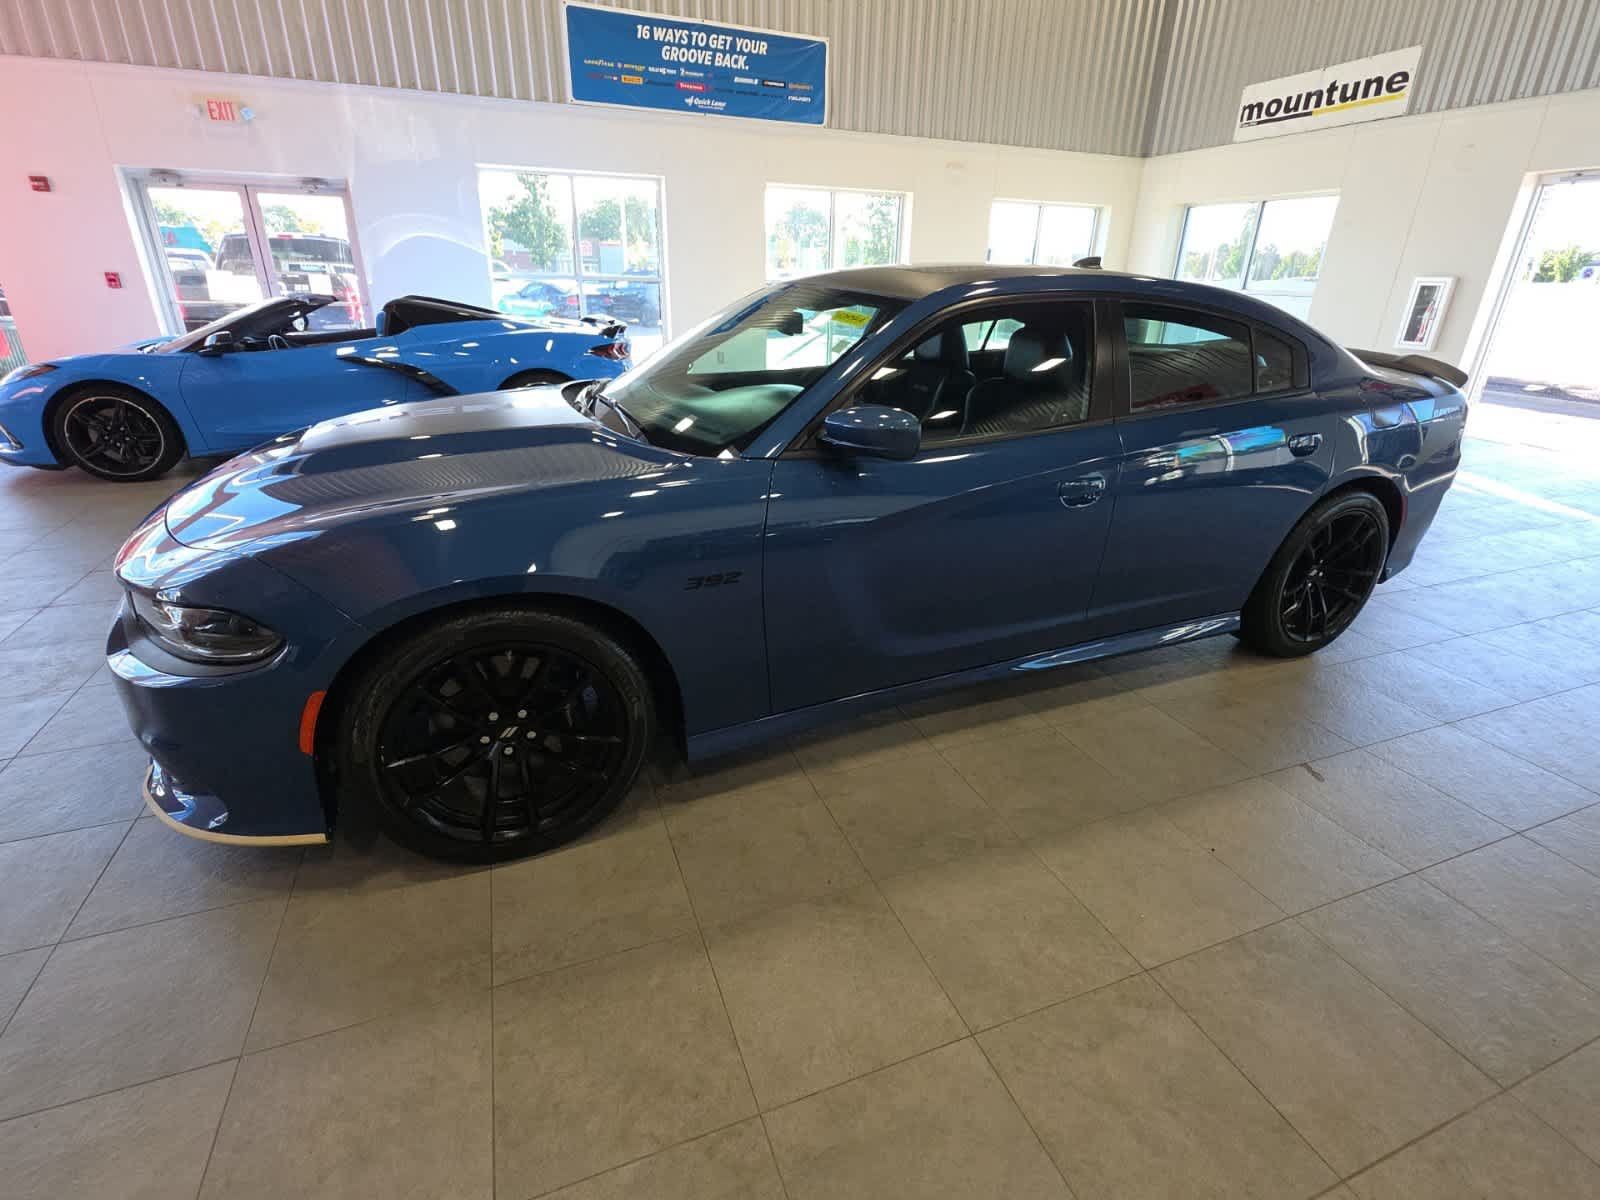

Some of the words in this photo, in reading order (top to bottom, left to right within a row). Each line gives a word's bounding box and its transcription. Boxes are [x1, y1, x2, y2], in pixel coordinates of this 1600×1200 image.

[636, 24, 650, 39] 16
[653, 26, 689, 45] WAYS
[691, 31, 707, 47] TO
[709, 33, 733, 50] GET
[735, 37, 768, 55] YOUR
[661, 45, 712, 65] GROOVE
[714, 53, 749, 71] BACK.
[694, 97, 712, 107] Quick
[1240, 71, 1410, 122] mountune
[207, 101, 234, 120] EXIT
